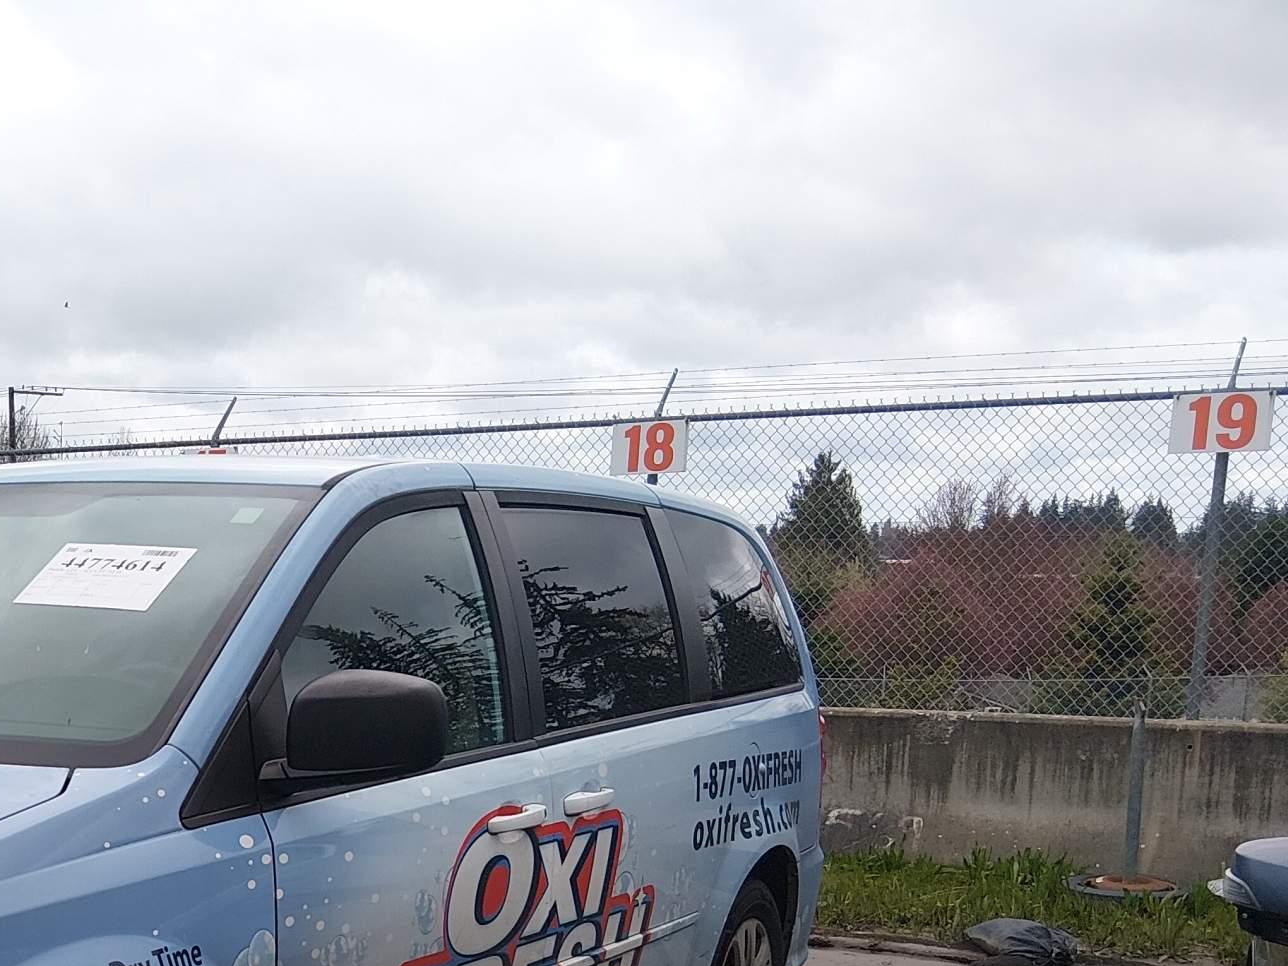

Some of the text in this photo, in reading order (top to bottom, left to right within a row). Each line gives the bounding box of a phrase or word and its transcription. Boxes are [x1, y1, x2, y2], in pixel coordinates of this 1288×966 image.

[623, 422, 675, 473] 18
[1187, 394, 1258, 451] 19
[61, 557, 166, 572] 44774614
[693, 748, 802, 803] 1-877-OXIFRESH
[692, 796, 800, 851] oxifresh.com
[446, 812, 620, 957] OXI
